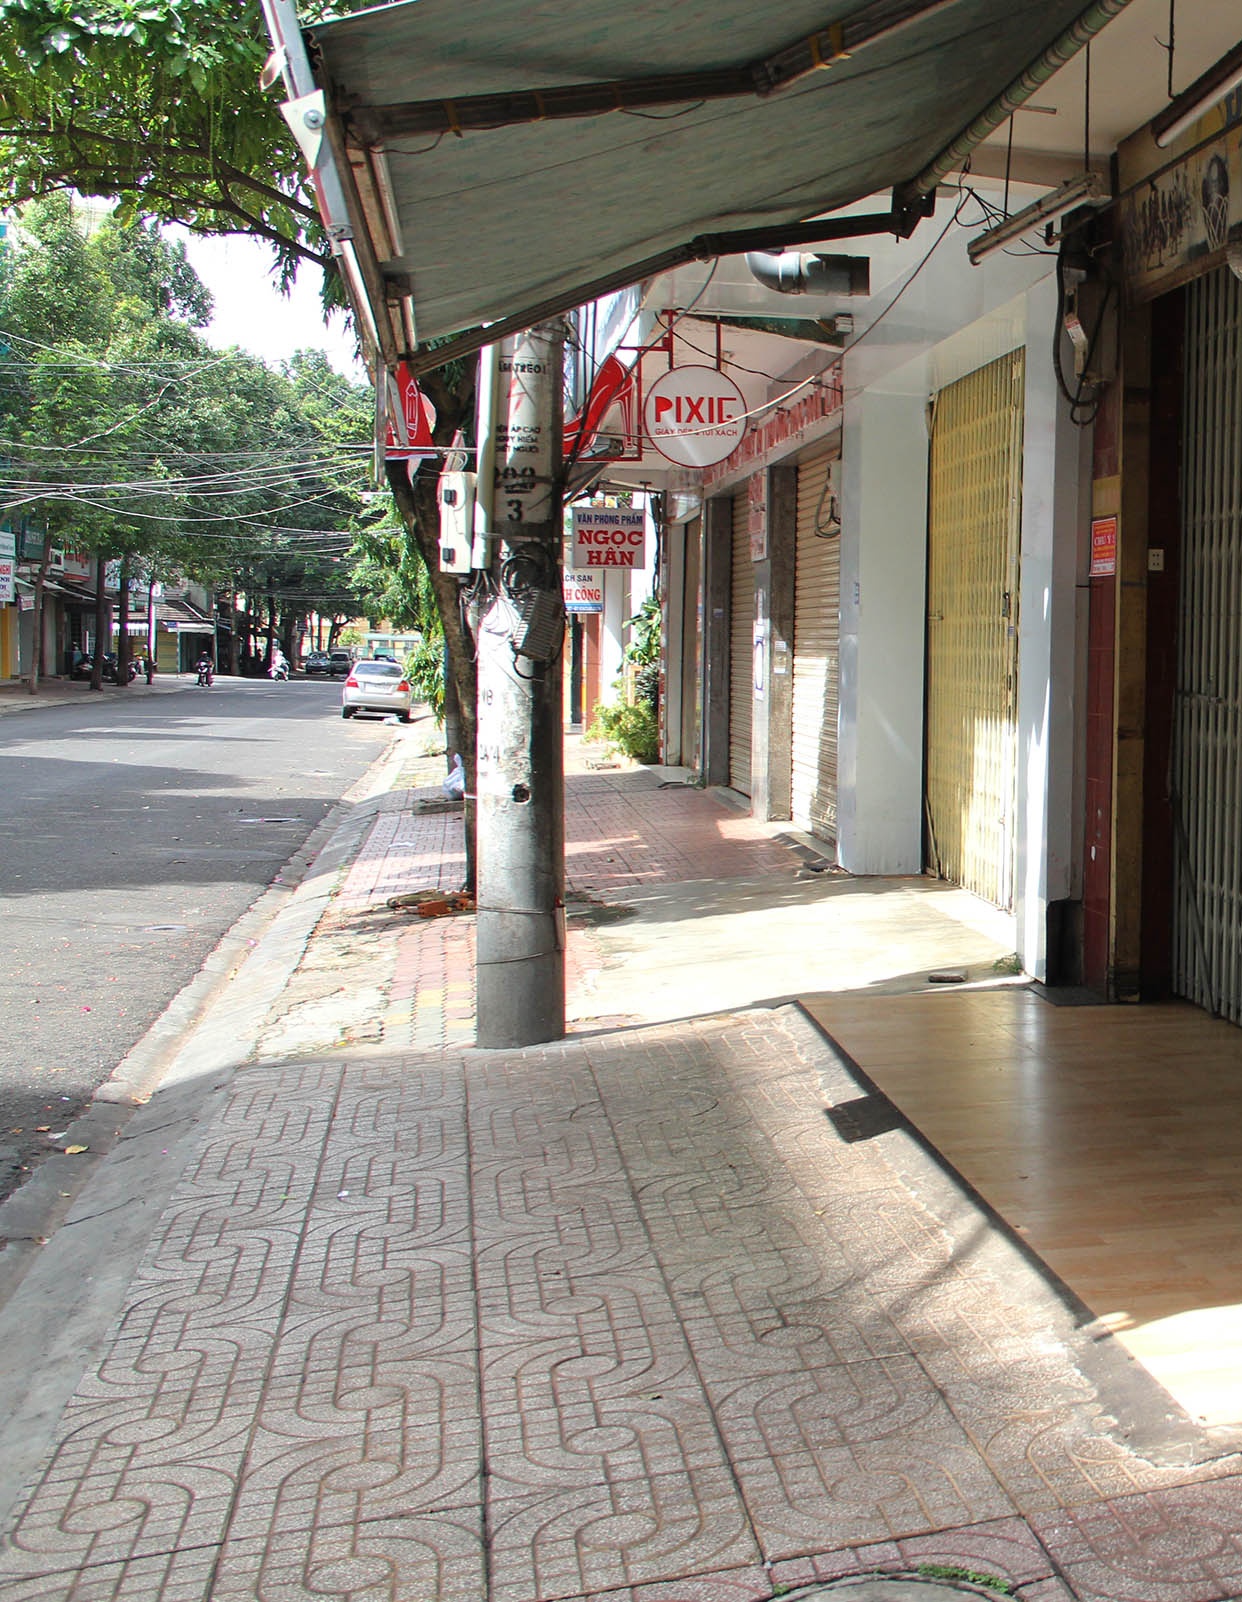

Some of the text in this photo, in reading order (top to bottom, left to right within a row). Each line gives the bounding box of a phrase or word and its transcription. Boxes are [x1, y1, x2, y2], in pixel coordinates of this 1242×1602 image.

[655, 396, 737, 424] PIXIE
[507, 500, 522, 521] 3
[577, 530, 643, 549] NGỌC
[586, 547, 635, 565] HÂN
